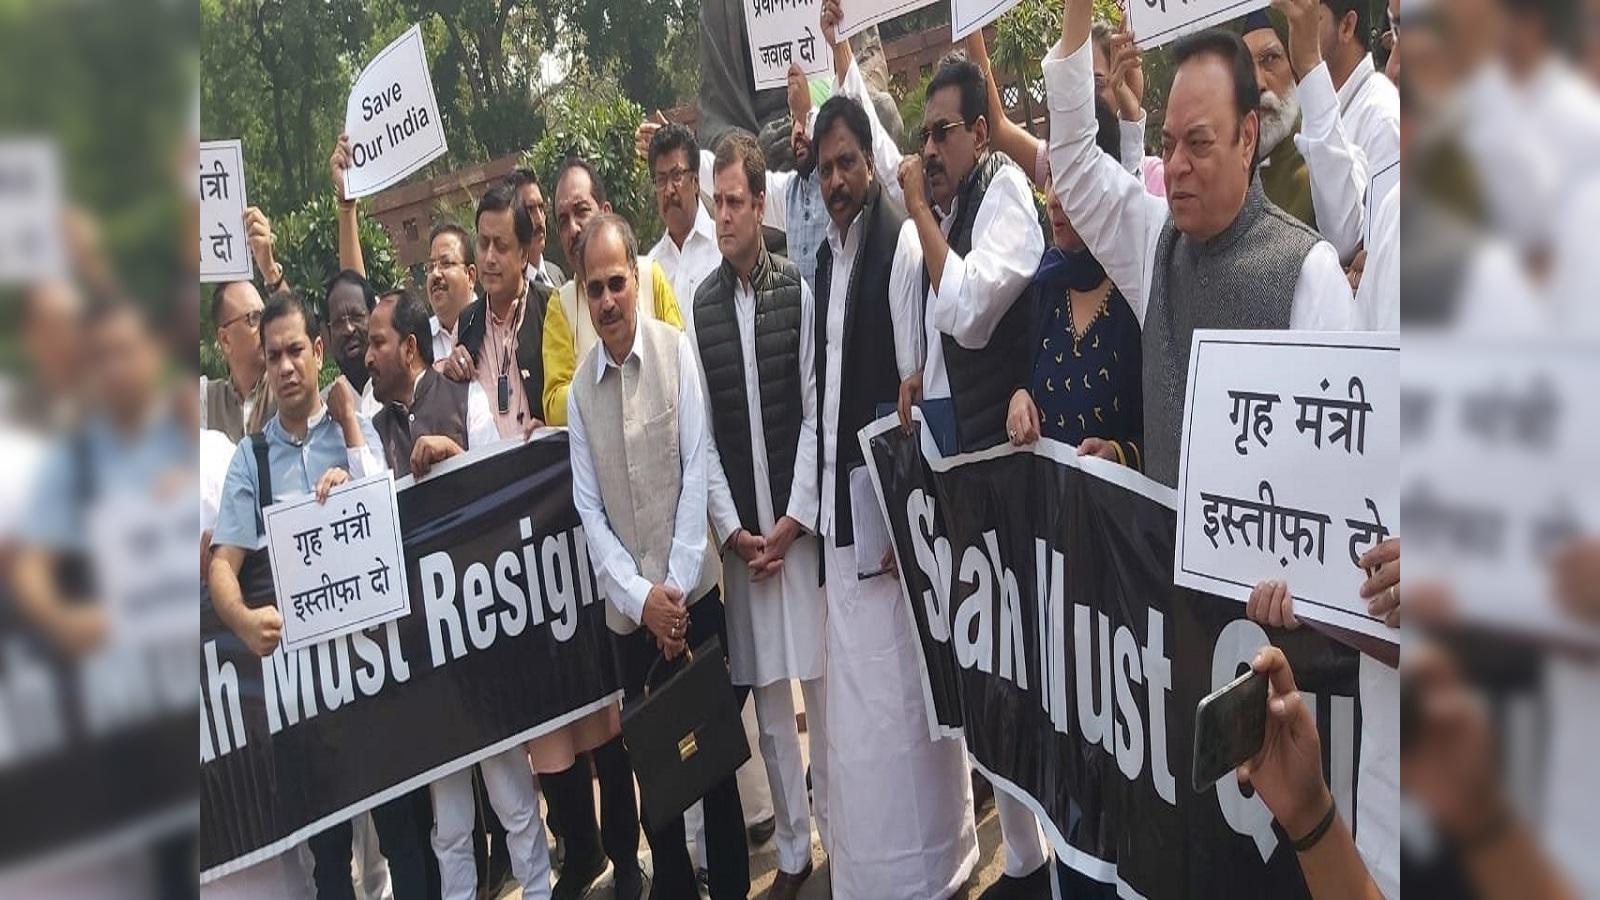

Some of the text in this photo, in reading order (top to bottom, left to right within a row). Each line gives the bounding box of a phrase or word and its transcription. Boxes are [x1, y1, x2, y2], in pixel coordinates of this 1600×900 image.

[759, 26, 816, 70] जवाब दो
[361, 82, 403, 122] Save
[352, 105, 430, 168] Our India
[210, 222, 232, 262] दो
[1227, 390, 1281, 455] गृह
[1293, 376, 1373, 455] मंत्री
[293, 502, 371, 566] गृह मंत्री
[1200, 480, 1332, 568] इस्तीफ़ा
[290, 557, 390, 622] इस्तीफ़ा दो
[261, 619, 411, 735] Must
